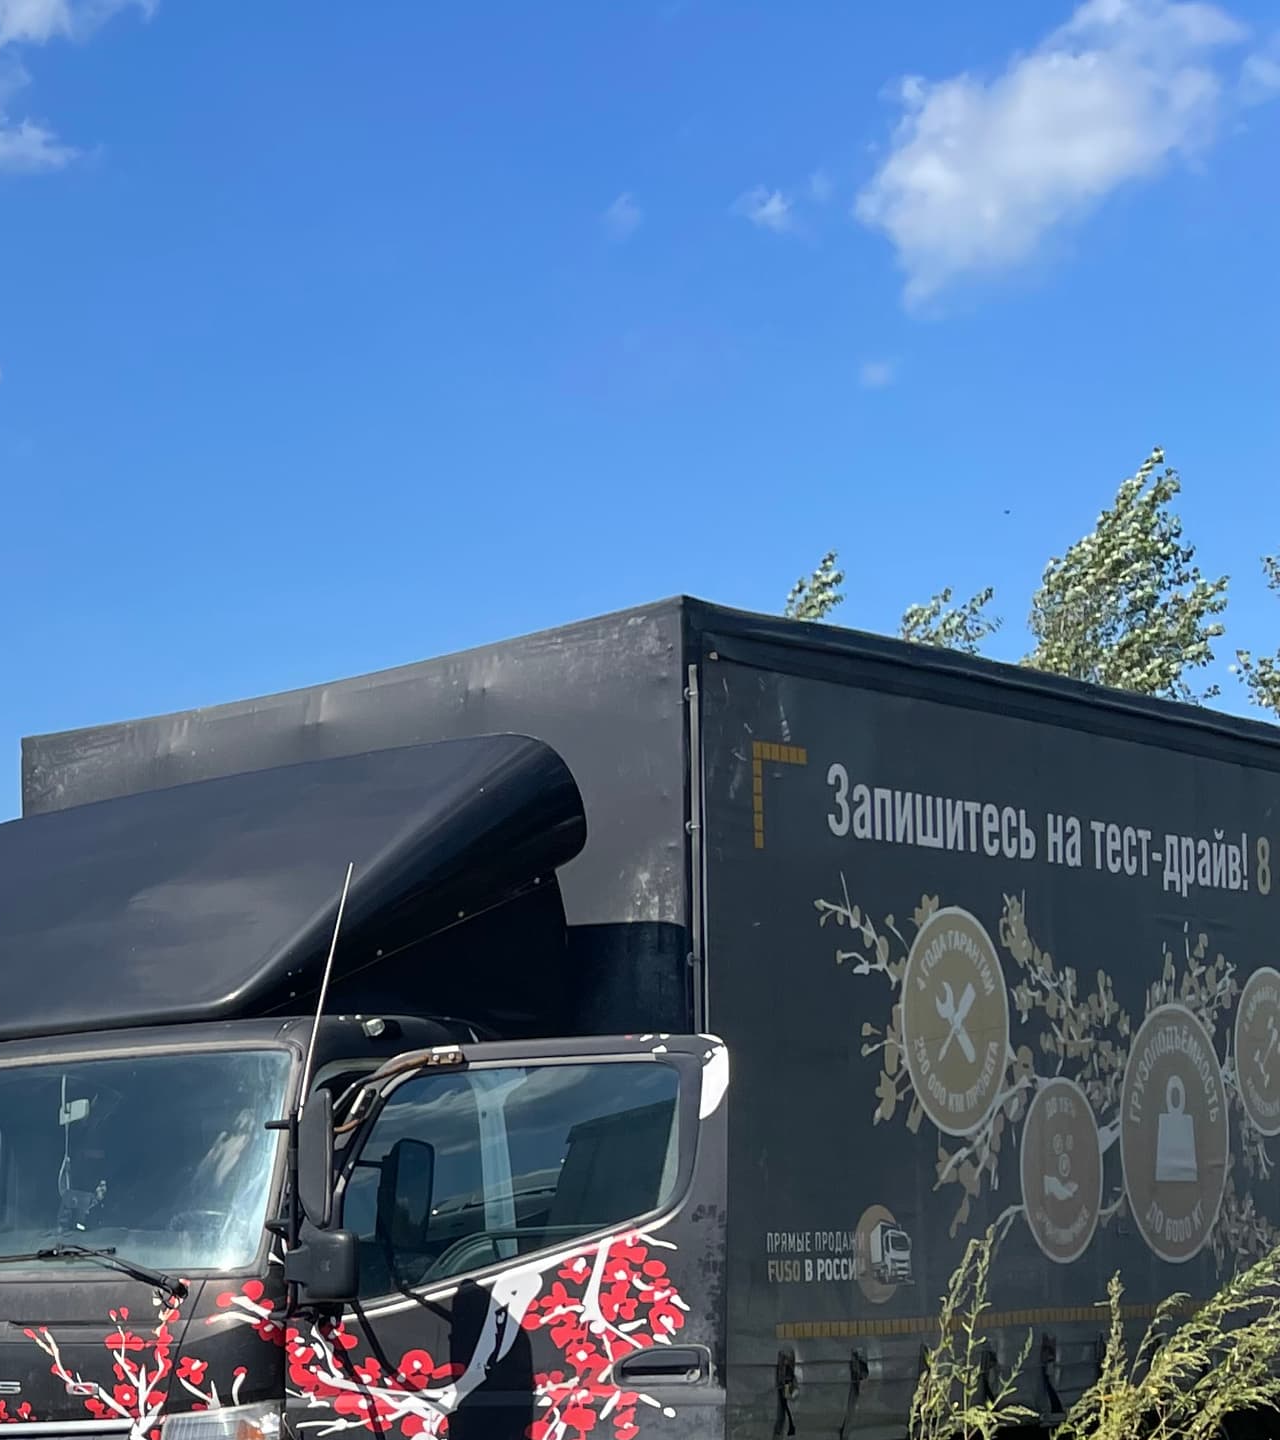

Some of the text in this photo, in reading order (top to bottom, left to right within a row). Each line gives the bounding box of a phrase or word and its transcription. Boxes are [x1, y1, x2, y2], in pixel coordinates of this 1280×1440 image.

[827, 763, 1036, 860] Запишитесь
[1046, 812, 1082, 867] на
[1090, 820, 1249, 897] тест-драйв!
[767, 1231, 811, 1253] ПРЯМЫЕ
[768, 1260, 800, 1282] FUSO
